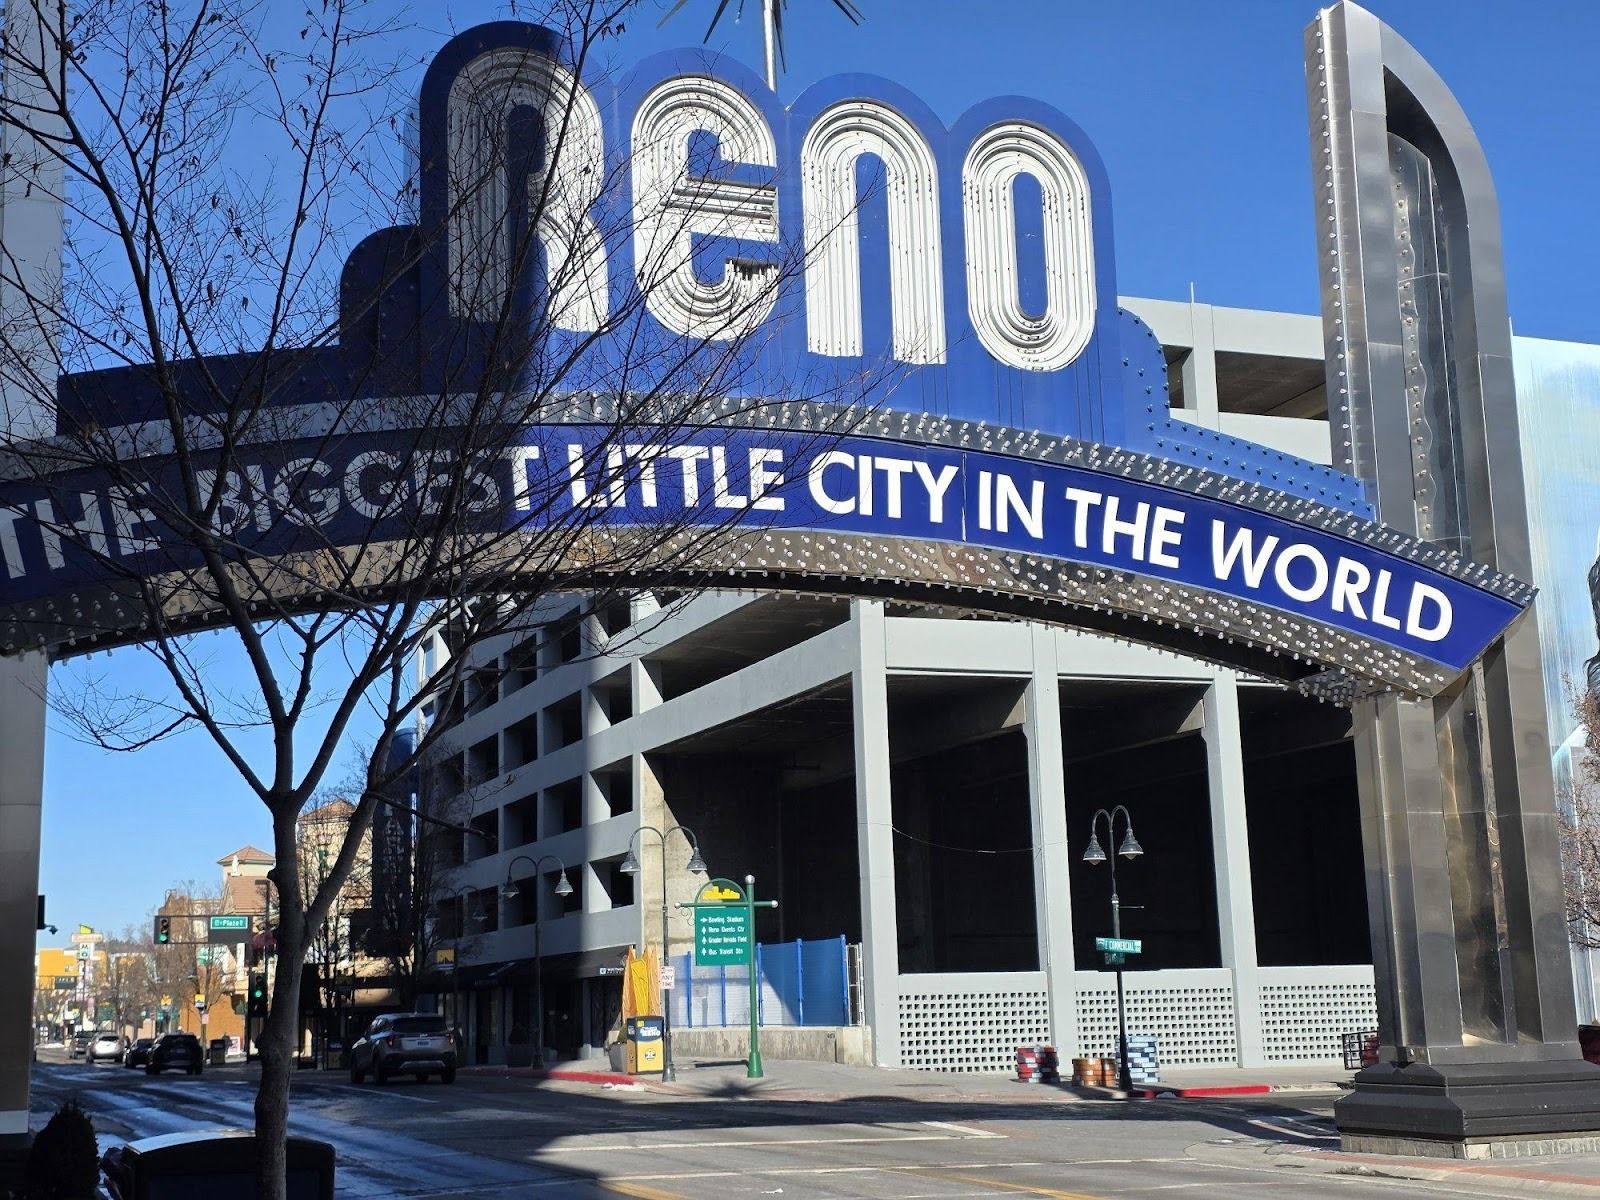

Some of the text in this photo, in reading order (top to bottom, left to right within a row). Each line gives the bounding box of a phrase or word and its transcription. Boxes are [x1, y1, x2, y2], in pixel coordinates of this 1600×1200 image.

[0, 445, 1453, 643] THE BIGGEST LITTLE CITY IN THE WORLD
